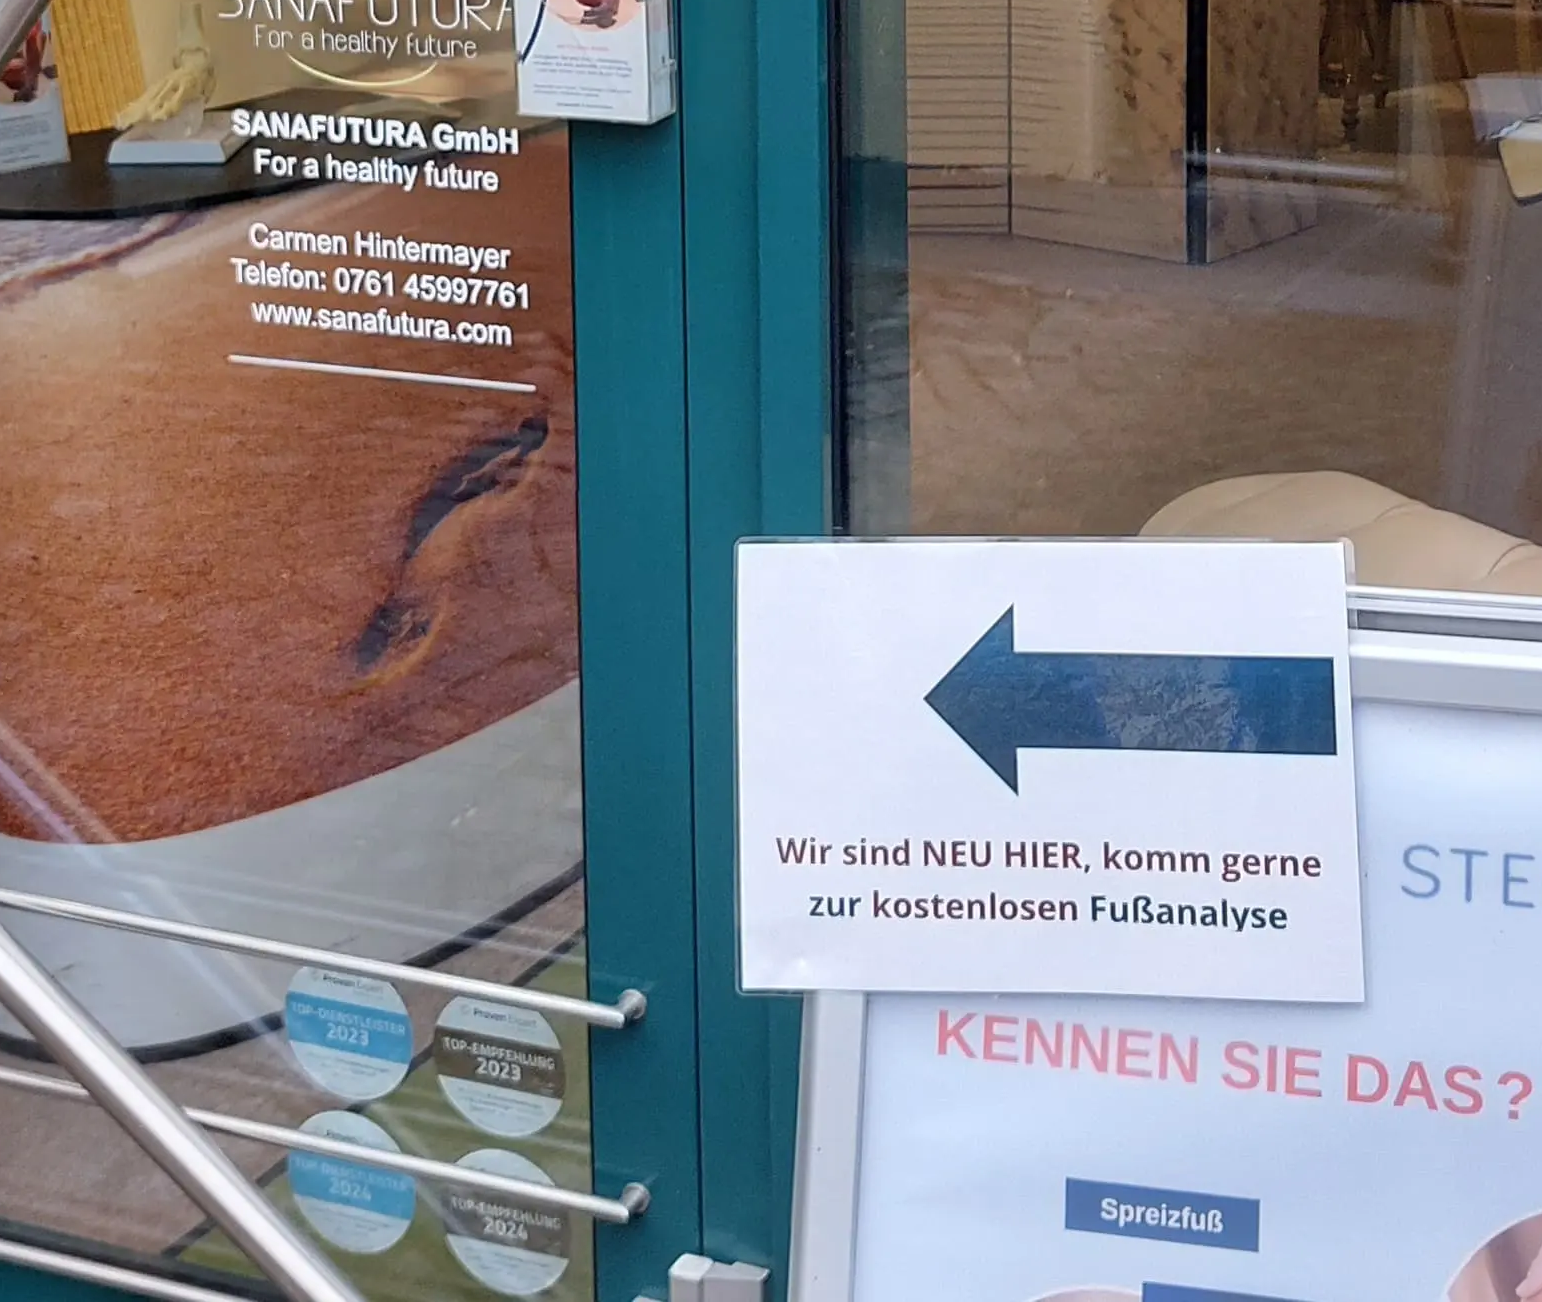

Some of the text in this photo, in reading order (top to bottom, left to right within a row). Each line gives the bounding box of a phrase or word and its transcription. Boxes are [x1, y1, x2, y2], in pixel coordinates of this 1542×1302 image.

[254, 24, 478, 60] For a healthy future
[230, 107, 520, 155] SANAFUTURA GmbH
[253, 148, 500, 193] For a healthy future
[247, 222, 511, 274] Carmen Hintermayer
[229, 256, 530, 311] Telefon: 0761 45997761
[250, 301, 513, 346] www.sanafutura.com
[775, 836, 1323, 883] Wir sind NEU HIER, komm gerne
[808, 889, 1289, 934] zur kostenlosen Fußanalyse
[325, 1021, 370, 1047] 2023
[441, 1036, 556, 1071] TOP-EMPFEHLUNG
[935, 1008, 1199, 1085] KENNEN
[1221, 1039, 1323, 1098] SIE
[475, 1056, 522, 1083] 2023
[327, 1178, 373, 1203] 2024
[482, 1215, 529, 1241] 2024
[1099, 1197, 1225, 1234] Spreizfuß
